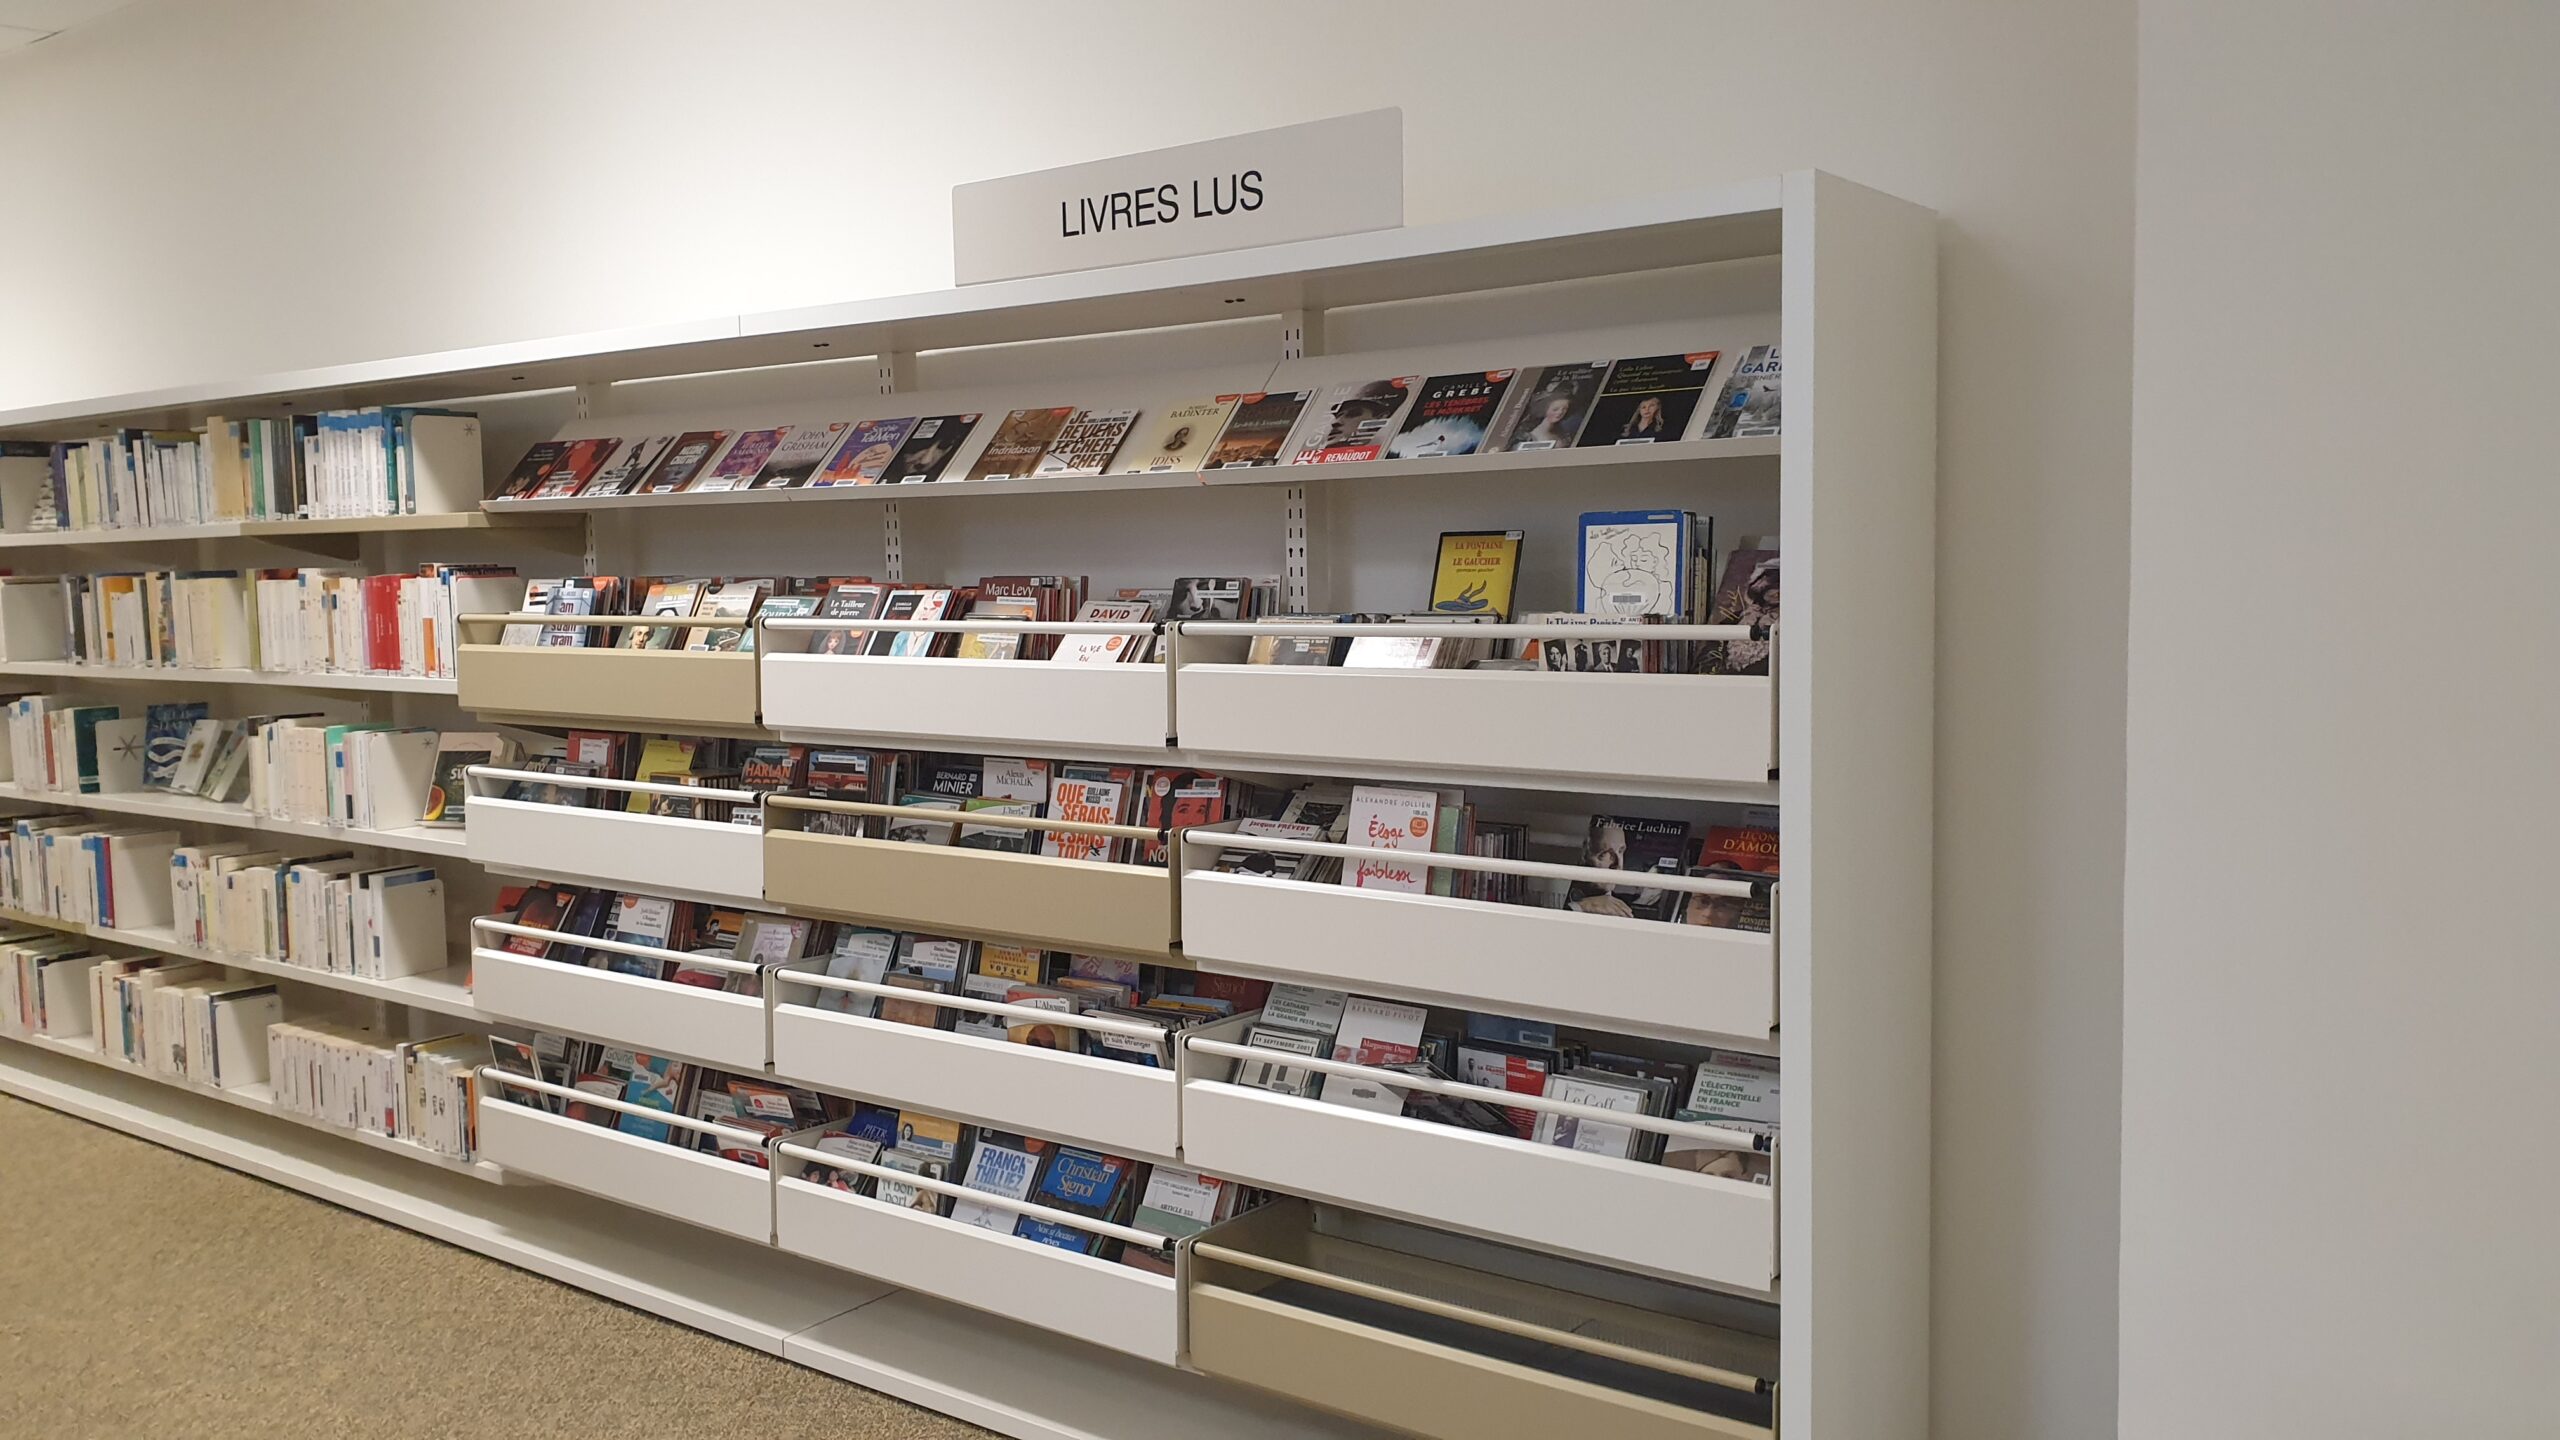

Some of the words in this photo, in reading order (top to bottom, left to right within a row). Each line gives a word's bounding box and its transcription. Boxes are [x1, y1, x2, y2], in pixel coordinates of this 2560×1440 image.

[1061, 183, 1180, 238] LIVRES
[1193, 169, 1264, 219] LUS
[1741, 361, 1781, 375] GAR
[1432, 386, 1493, 399] GREBE
[1069, 410, 1092, 424] JE
[1169, 407, 1220, 419] BADINTER
[798, 431, 828, 441] JOHN
[1058, 421, 1127, 440] REVIENS
[781, 440, 829, 452] GRISHAM
[1066, 453, 1112, 468] CHER
[1150, 455, 1183, 466] IDISS
[1324, 450, 1371, 463] RENAUDOT
[1452, 557, 1463, 566] LE
[1463, 557, 1501, 566] GAUCHER
[985, 583, 1010, 596] Marc
[1011, 583, 1035, 598] Levy
[559, 601, 574, 613] am
[830, 600, 839, 608] Le
[840, 599, 866, 608] Tailleur
[830, 608, 839, 616] de
[839, 609, 860, 618] pierre
[1090, 608, 1131, 620] DAVID
[745, 762, 792, 778] HARLAN
[936, 770, 968, 782] BERNARD
[1009, 770, 1030, 780] Alexis
[932, 777, 974, 795] MINIER
[1056, 783, 1086, 807] QUE
[1355, 796, 1398, 806] ALEXANDRE
[1400, 800, 1431, 809] JOLLIEN
[1061, 804, 1115, 824] SERAIS-
[1368, 814, 1405, 848] Éloge
[1594, 817, 1637, 831] Fabrice
[1637, 821, 1683, 835] Luchini
[1723, 838, 1779, 855] D'AMOU
[989, 964, 1029, 977] VOYAGE
[1267, 1010, 1276, 1018] LA
[1277, 1012, 1300, 1024] GRANDE
[1300, 1017, 1315, 1027] PESTE
[1351, 1004, 1390, 1017] BERNARD
[1393, 1010, 1421, 1022] PIVOT
[1263, 1038, 1295, 1049] SEPTEMBRE
[1296, 1043, 1311, 1052] 2001
[1700, 1079, 1745, 1093] L'ÉLECTION
[1584, 1093, 1617, 1109] Goff
[1696, 1095, 1708, 1104] EN
[1708, 1097, 1741, 1108] FRANCE
[1698, 1087, 1762, 1103] PRÉSIDENTIELLE
[980, 1146, 1027, 1175] FRANCK
[974, 1163, 1024, 1188] THILLIEZ
[1057, 1156, 1111, 1185] Christian
[1056, 1173, 1096, 1198] Signol
[1160, 1203, 1183, 1214] ARTICLE
